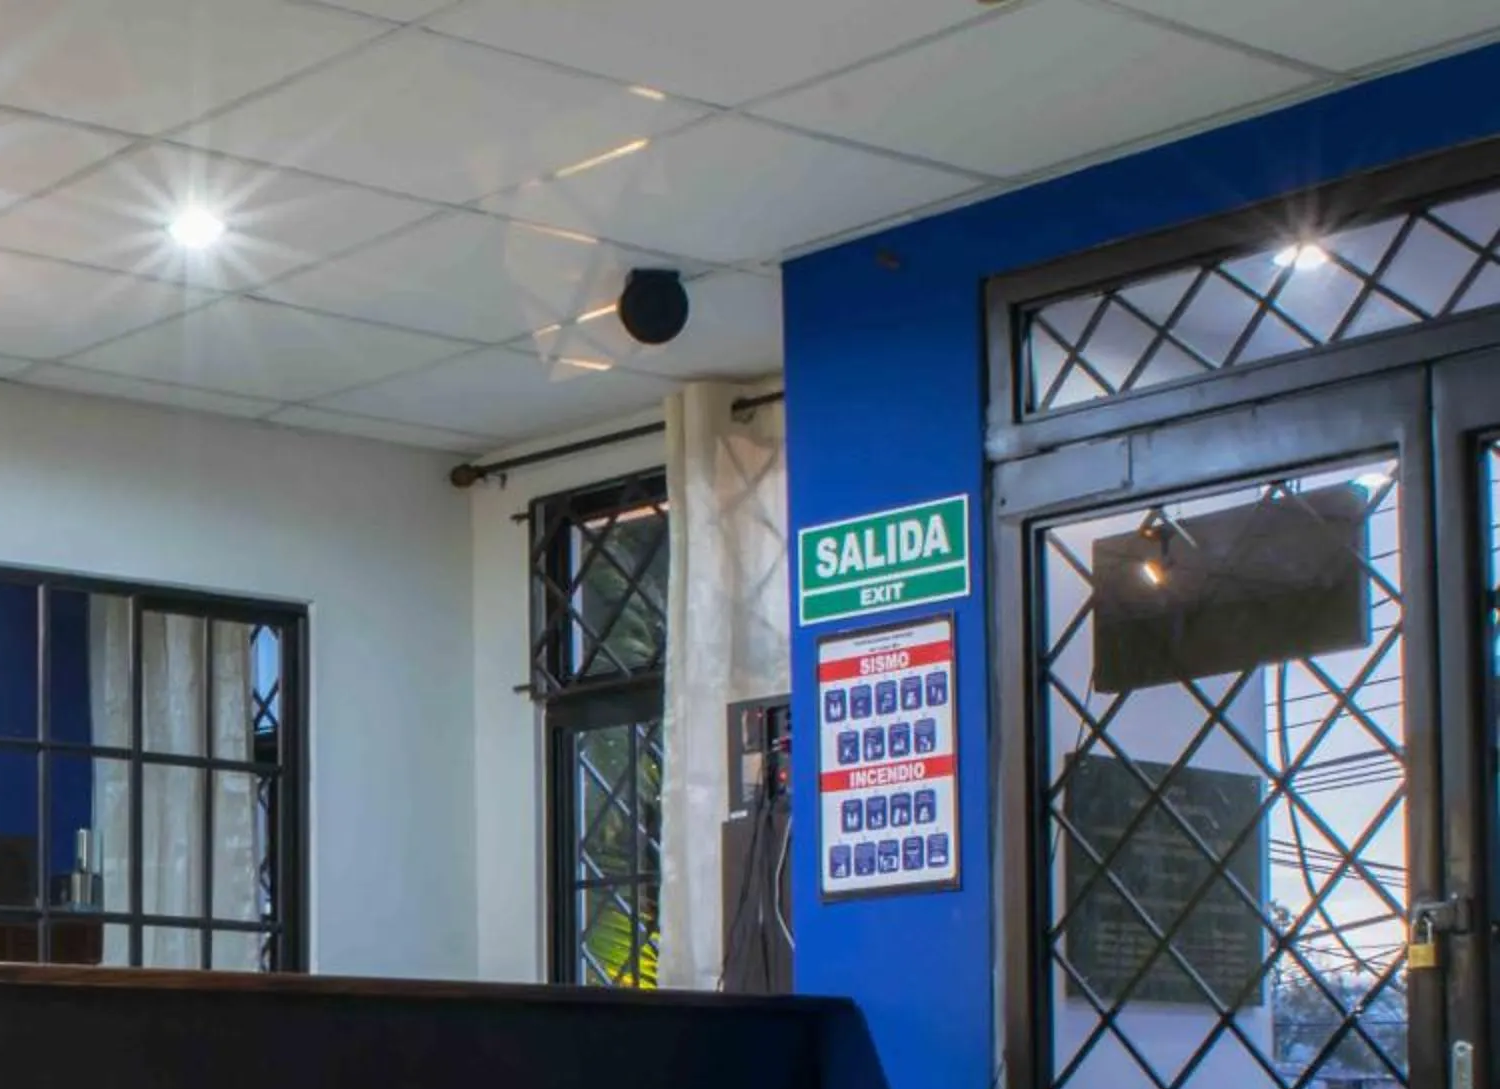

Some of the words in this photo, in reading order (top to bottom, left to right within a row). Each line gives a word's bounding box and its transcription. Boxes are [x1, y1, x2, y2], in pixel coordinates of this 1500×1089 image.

[816, 513, 951, 578] SALIDA
[860, 582, 905, 606] EXIT
[859, 651, 910, 675] SISMO
[850, 761, 926, 788] INCENDIO
